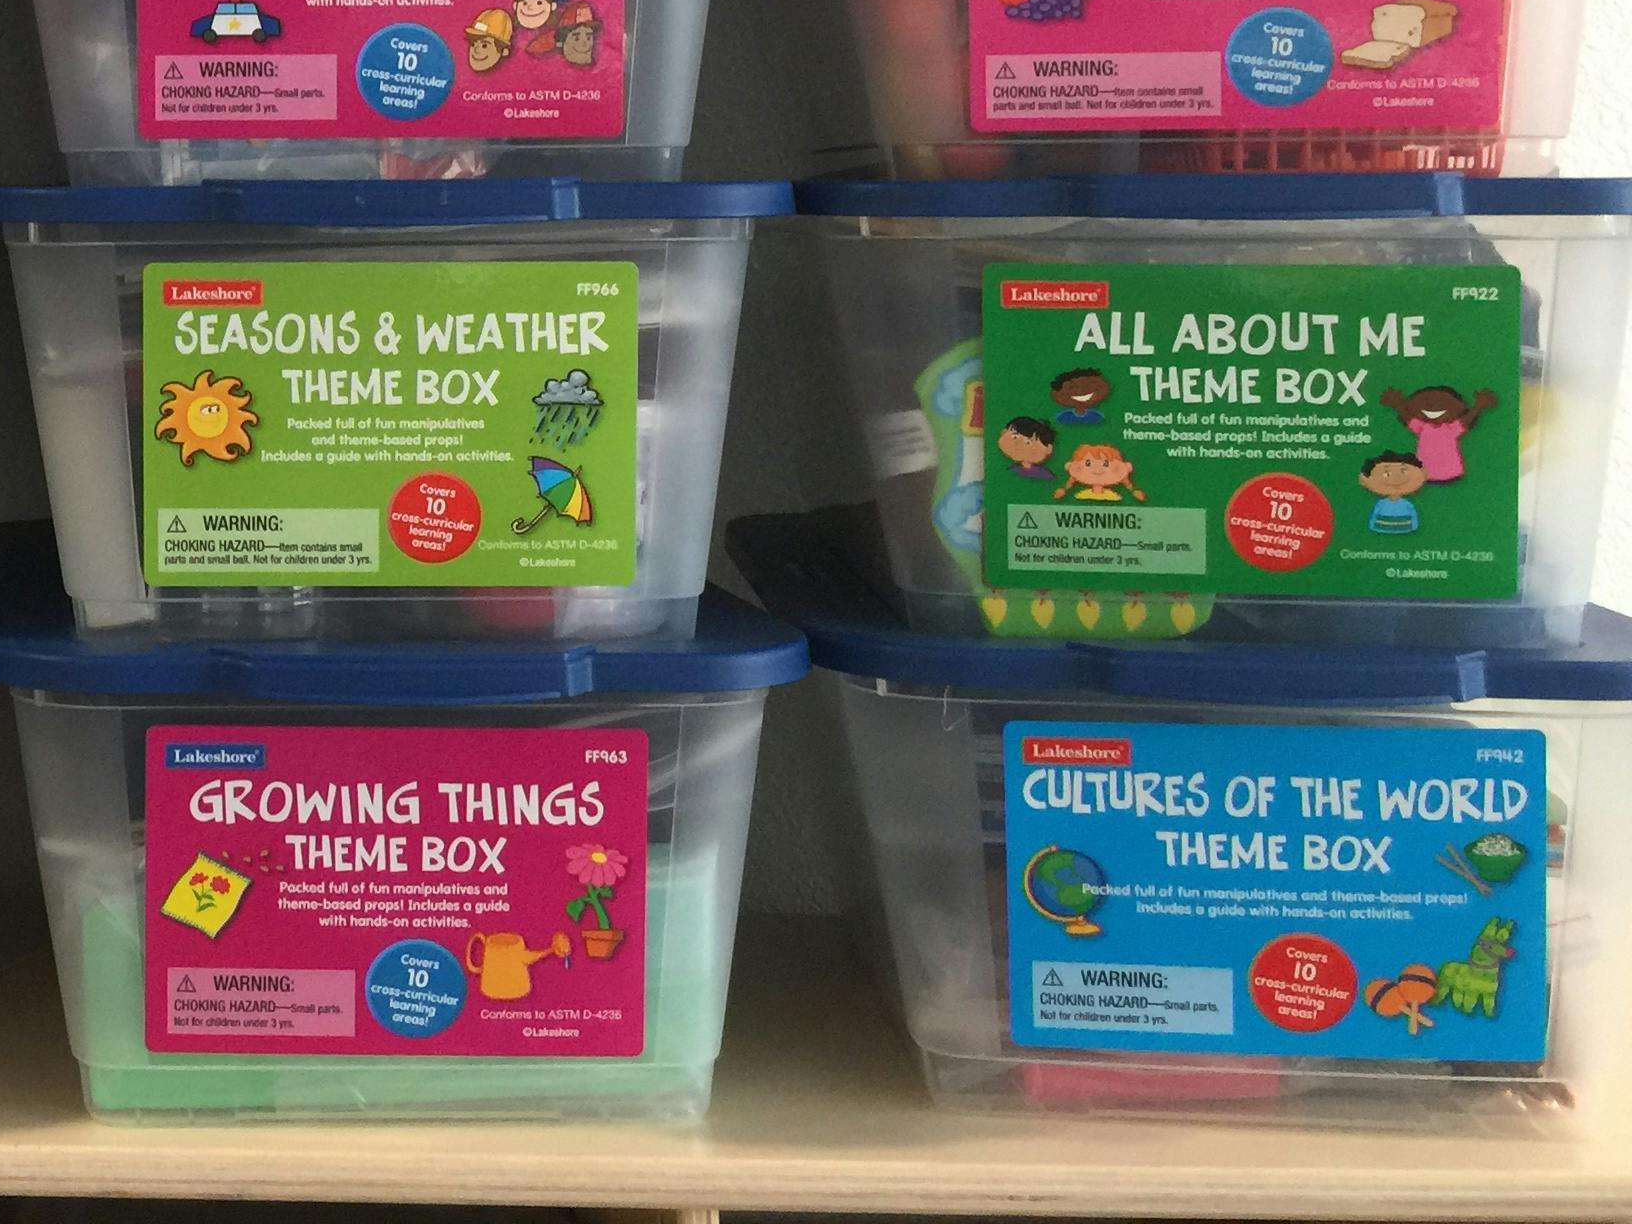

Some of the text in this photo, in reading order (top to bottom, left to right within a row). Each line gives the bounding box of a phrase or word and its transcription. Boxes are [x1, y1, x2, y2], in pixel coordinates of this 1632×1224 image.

[200, 61, 278, 78] WARNING:
[1033, 60, 1118, 77] WARNING:
[172, 287, 253, 301] Lakeshore
[577, 282, 619, 296] FF966
[1010, 287, 1098, 303] Lakeshore
[1452, 287, 1499, 301] FF922
[174, 310, 609, 356] SEASONS & WEATHER
[1074, 312, 1426, 357] ALL ABOUT ME
[282, 369, 501, 406] THEME BOX
[1130, 367, 1367, 406] THEME BOX
[203, 515, 283, 532] WARNING:
[1055, 512, 1141, 530] WARNING:
[174, 750, 256, 764] Lakeshore
[585, 750, 628, 764] FF963
[1032, 744, 1119, 759] Lakeshore
[1476, 748, 1524, 763] FF942
[189, 779, 604, 826] GROWING THINGS
[1022, 769, 1528, 823] CULTURES OF THE WORLD
[285, 836, 507, 874] THEME BOX
[1156, 831, 1392, 874] THEME BOX
[278, 899, 510, 914] theme-based props! Includes a guide
[213, 975, 294, 993] WARNING:
[1081, 970, 1168, 991] WARNING:
